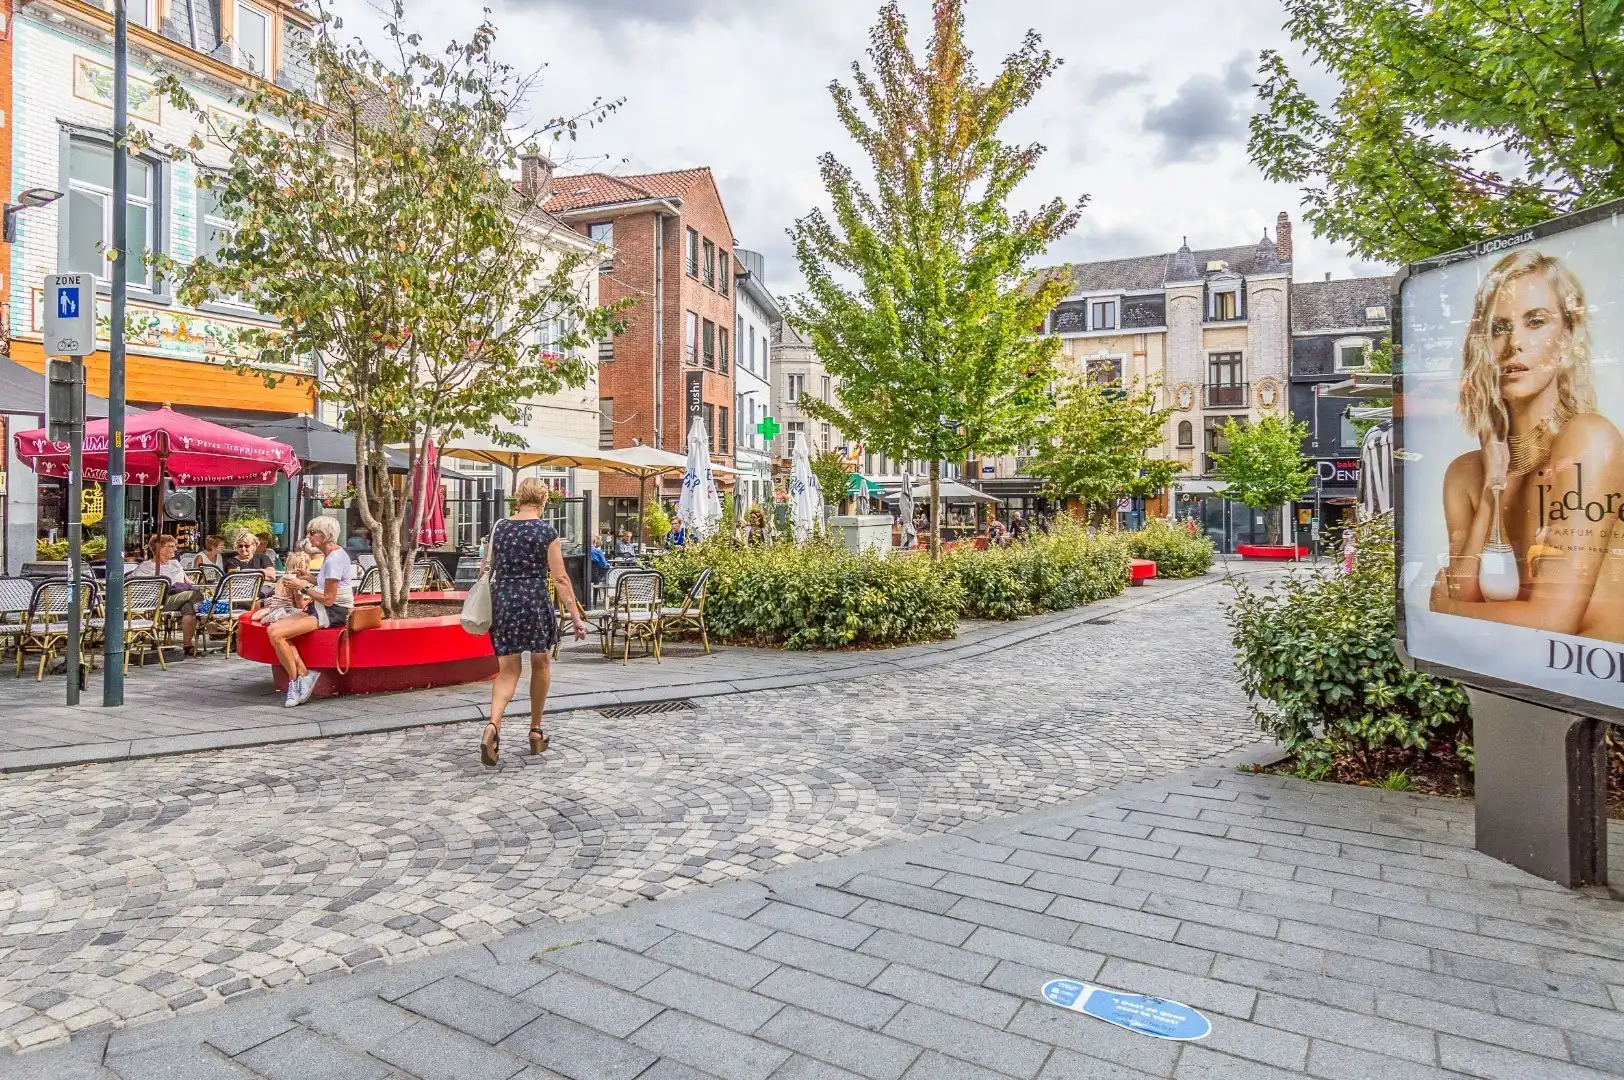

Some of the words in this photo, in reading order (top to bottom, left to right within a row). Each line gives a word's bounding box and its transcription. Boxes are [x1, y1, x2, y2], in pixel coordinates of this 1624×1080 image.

[1480, 231, 1534, 255] JCDecaux
[55, 276, 81, 285] ZONE
[1546, 528, 1593, 537] PARFUM
[1545, 638, 1624, 683] DIO
